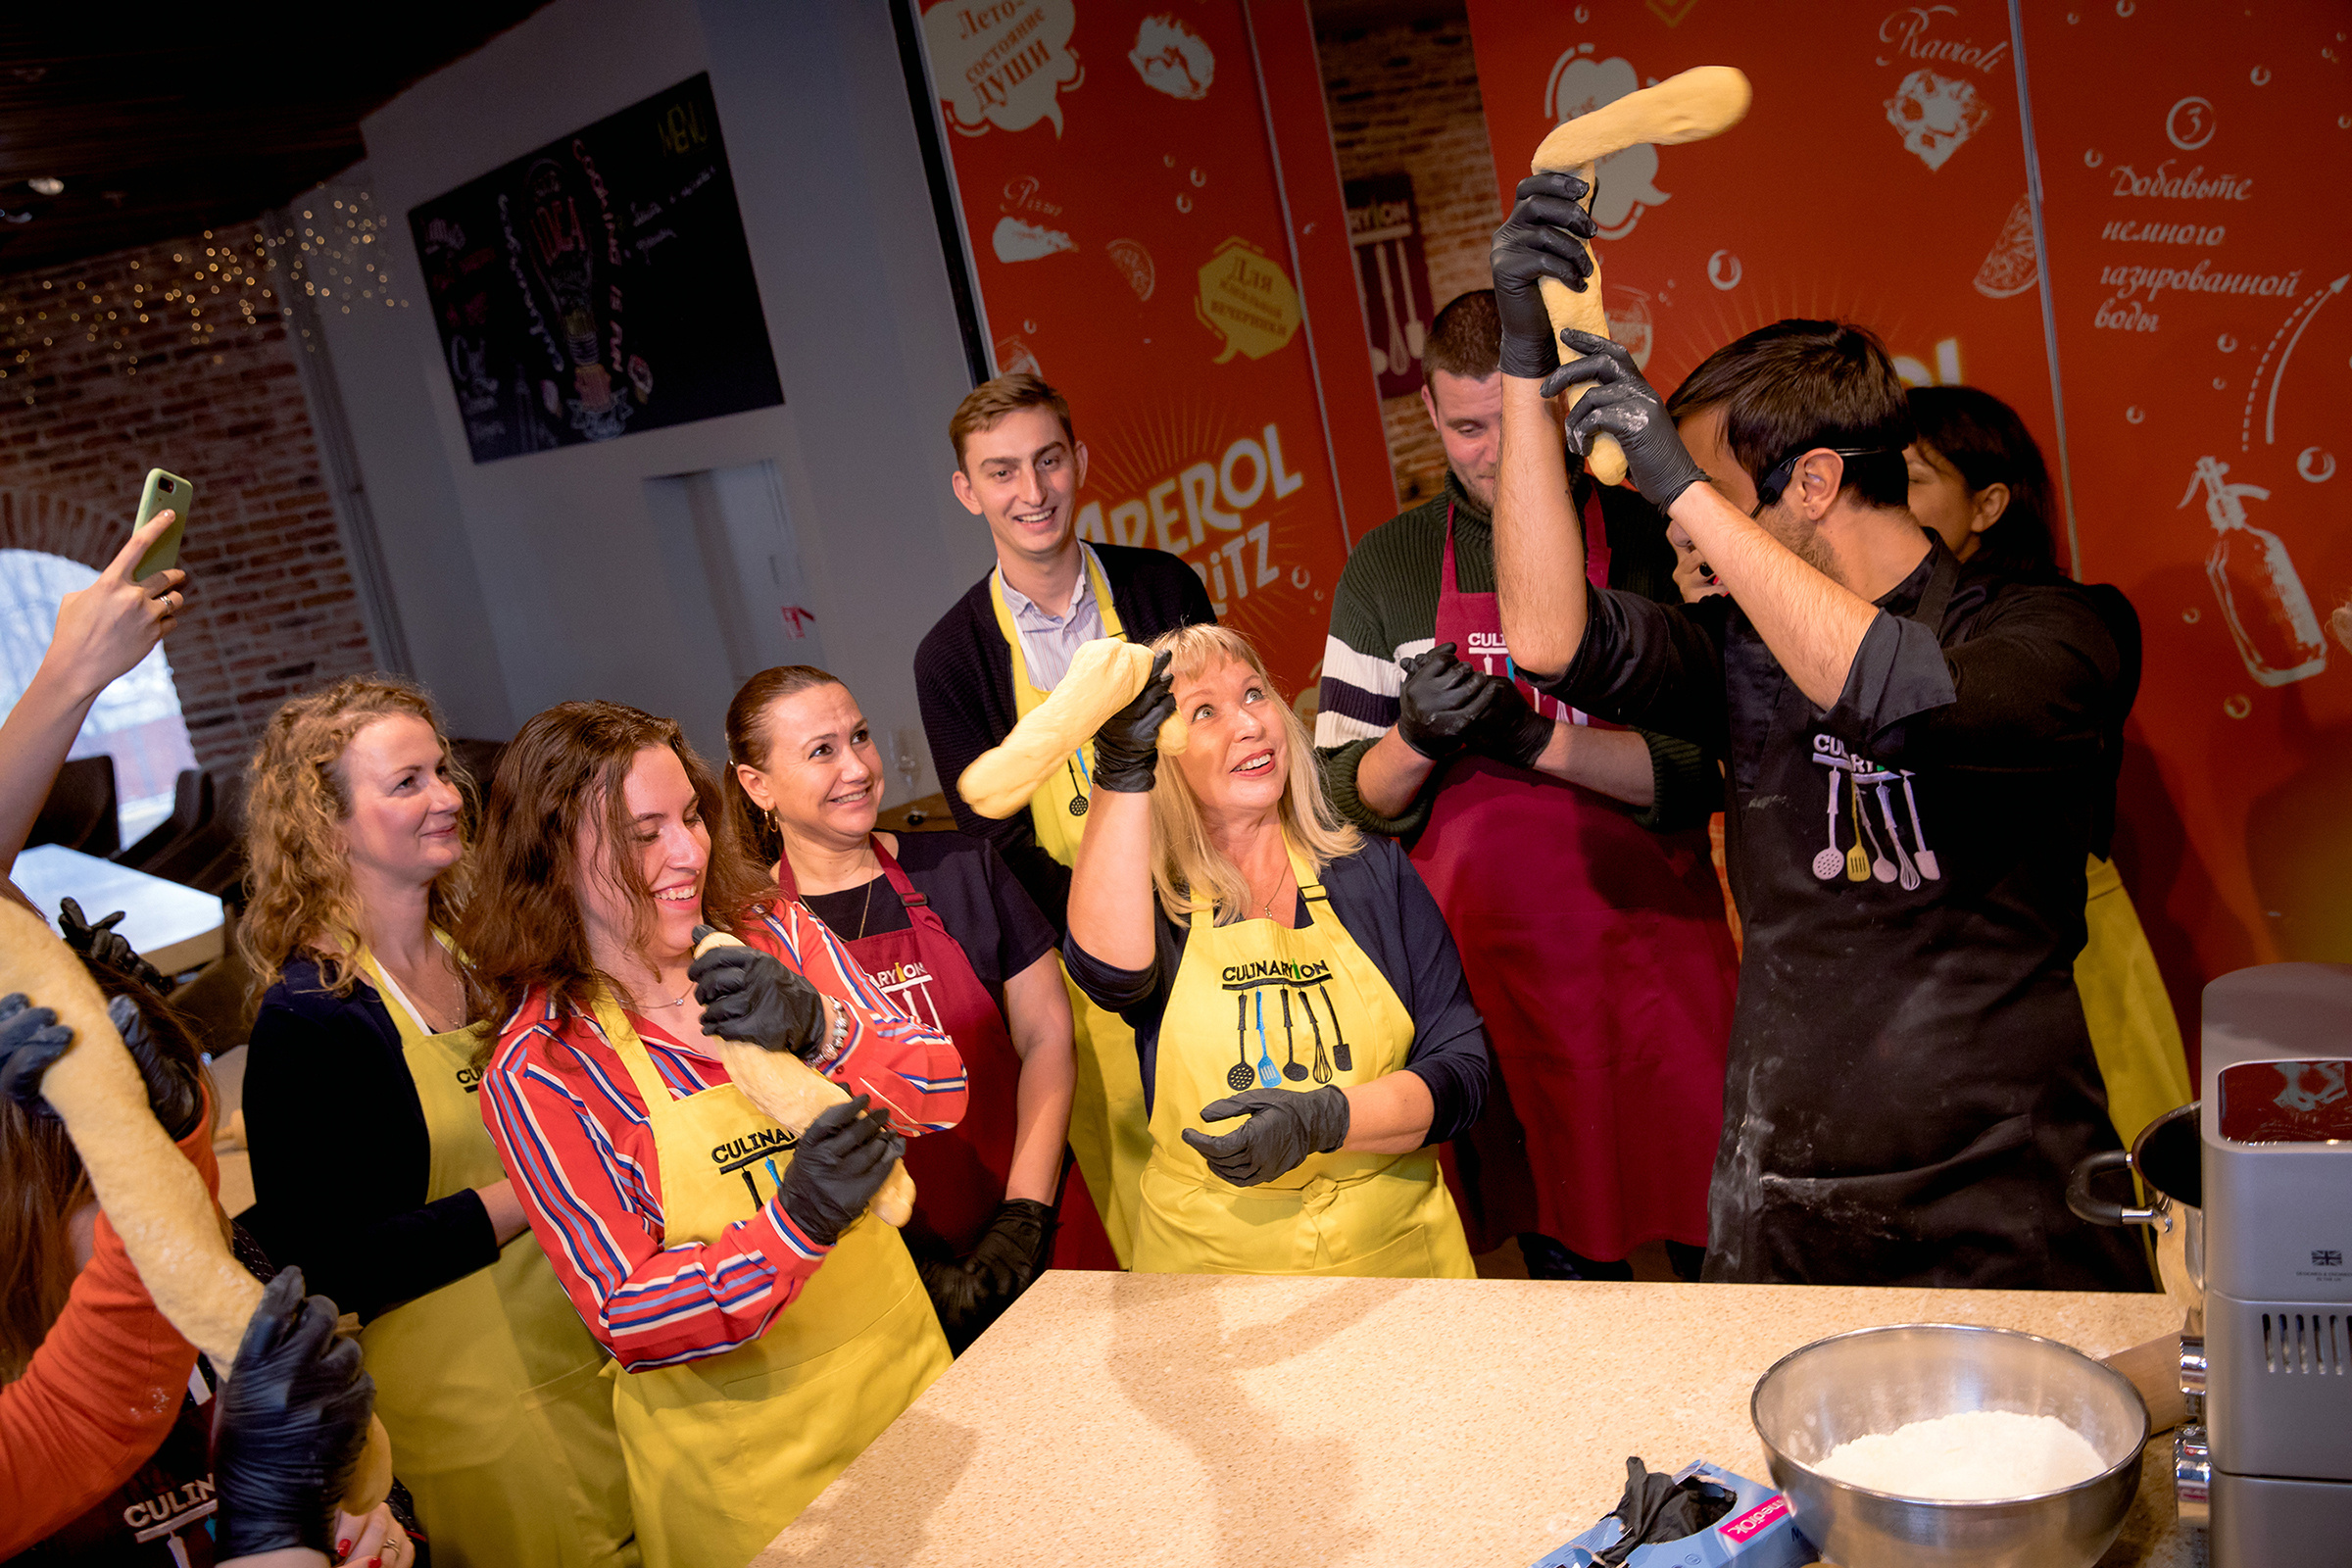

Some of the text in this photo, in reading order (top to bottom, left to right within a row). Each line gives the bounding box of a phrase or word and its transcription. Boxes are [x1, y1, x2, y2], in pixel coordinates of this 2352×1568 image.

[966, 8, 1046, 83] состояние
[1876, 5, 2008, 73] Ravioli
[2181, 106, 2203, 141] 3
[2109, 158, 2253, 201] Добавьте
[2101, 220, 2227, 246] немного
[1228, 256, 1273, 295] Для
[2100, 258, 2304, 302] газированной
[2094, 297, 2160, 333] воды
[1075, 422, 1303, 557] APEROL
